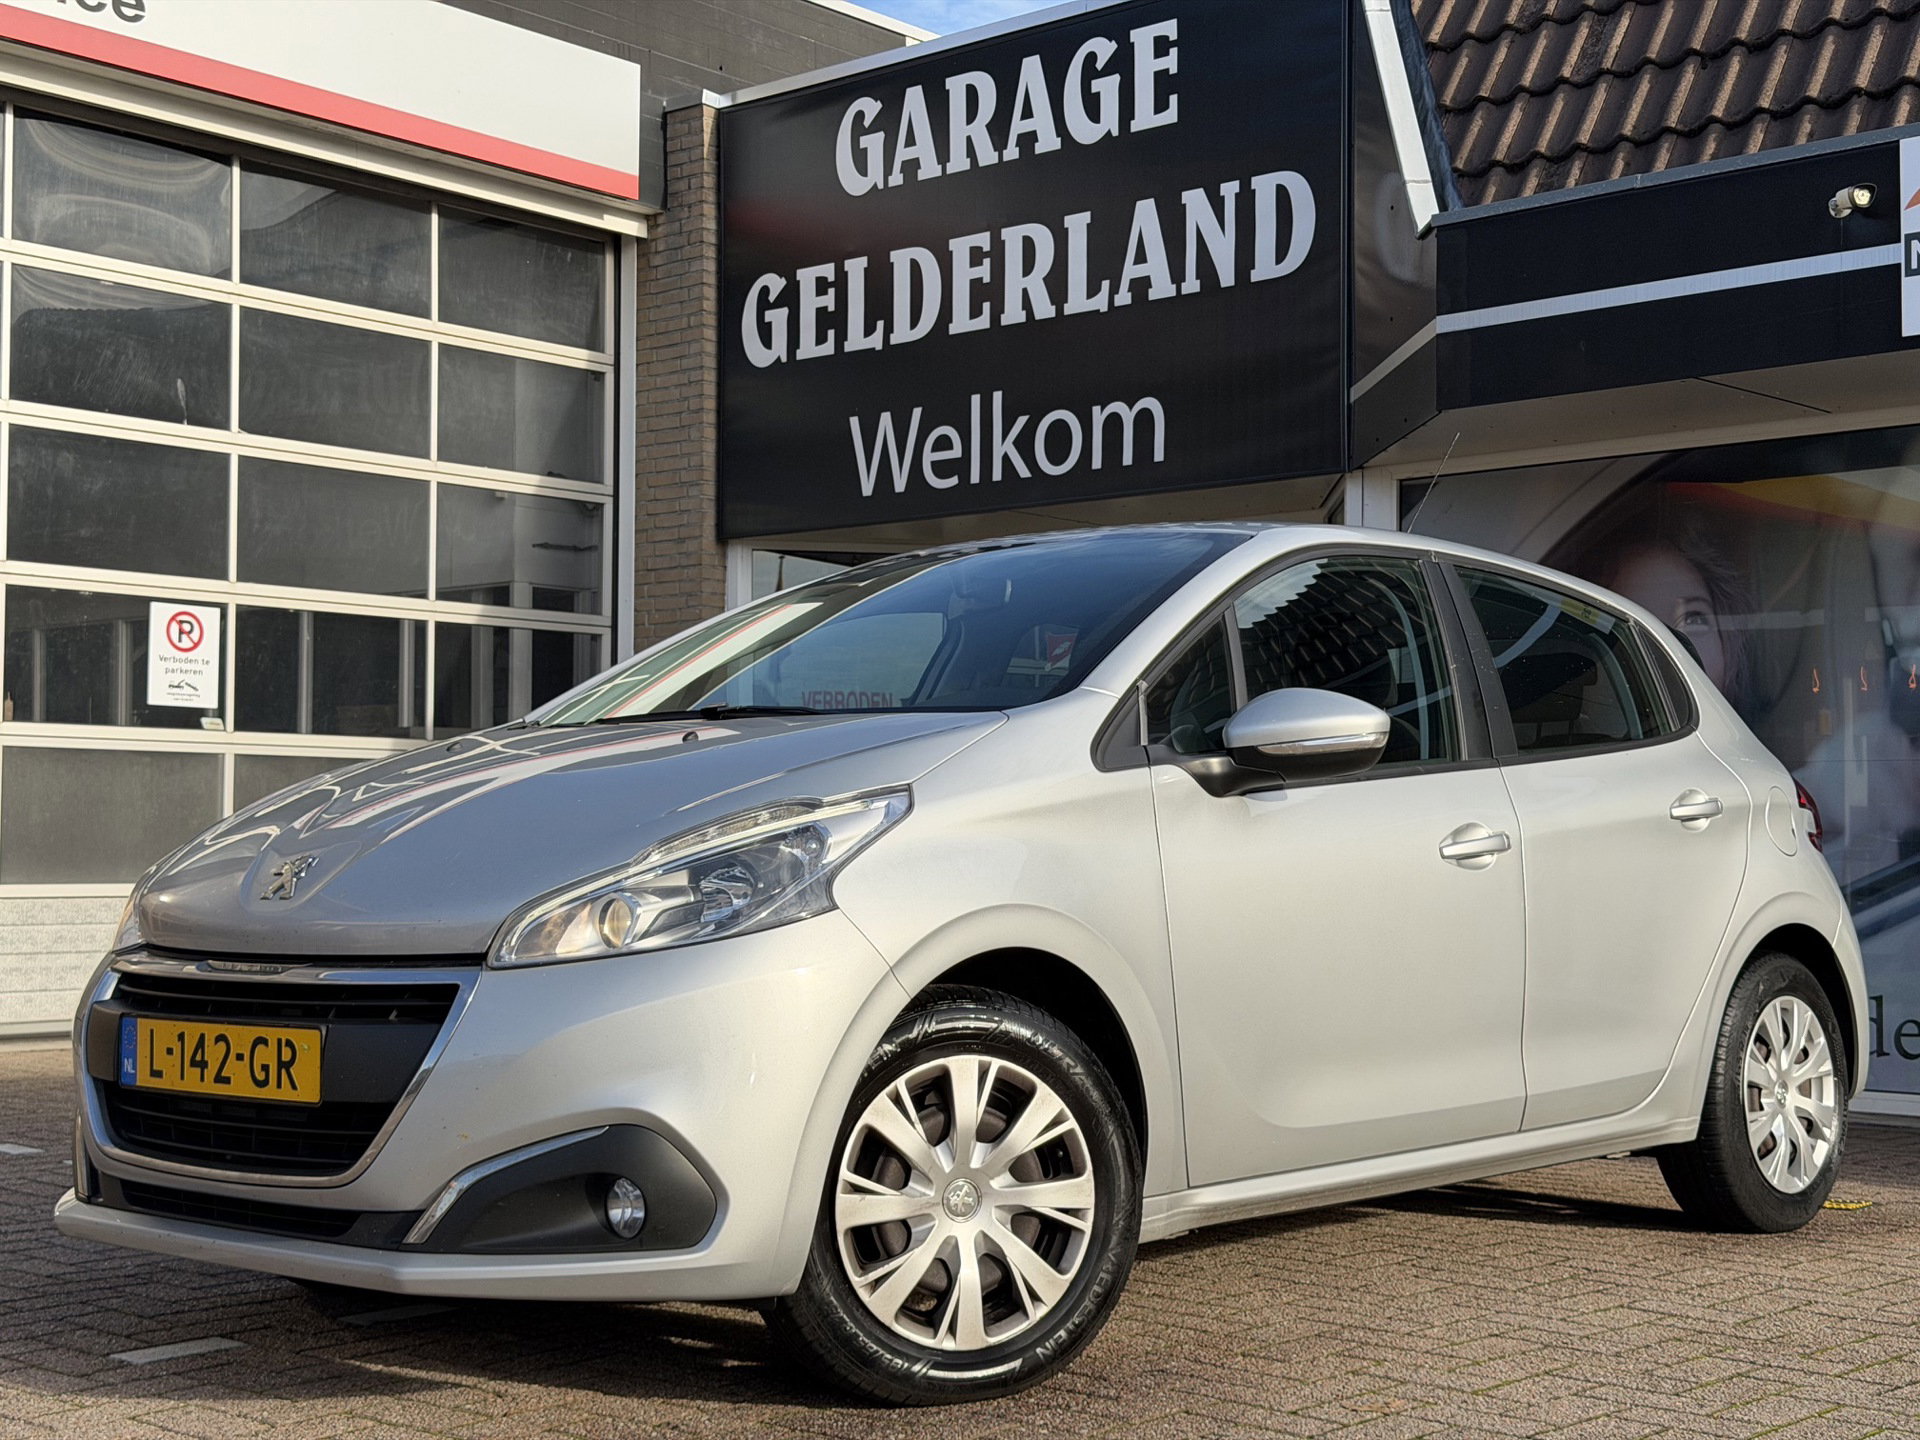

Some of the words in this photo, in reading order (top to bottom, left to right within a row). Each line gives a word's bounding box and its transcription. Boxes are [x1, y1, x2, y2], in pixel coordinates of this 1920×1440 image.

[835, 18, 1178, 197] GARAGE
[741, 170, 1316, 368] GELDERLAND
[849, 390, 1165, 497] Welkom
[158, 654, 199, 666] Verboden
[202, 657, 211, 666] te
[164, 666, 204, 677] parkeren
[123, 1057, 136, 1074] NL
[149, 1027, 299, 1091] L-142-GR
